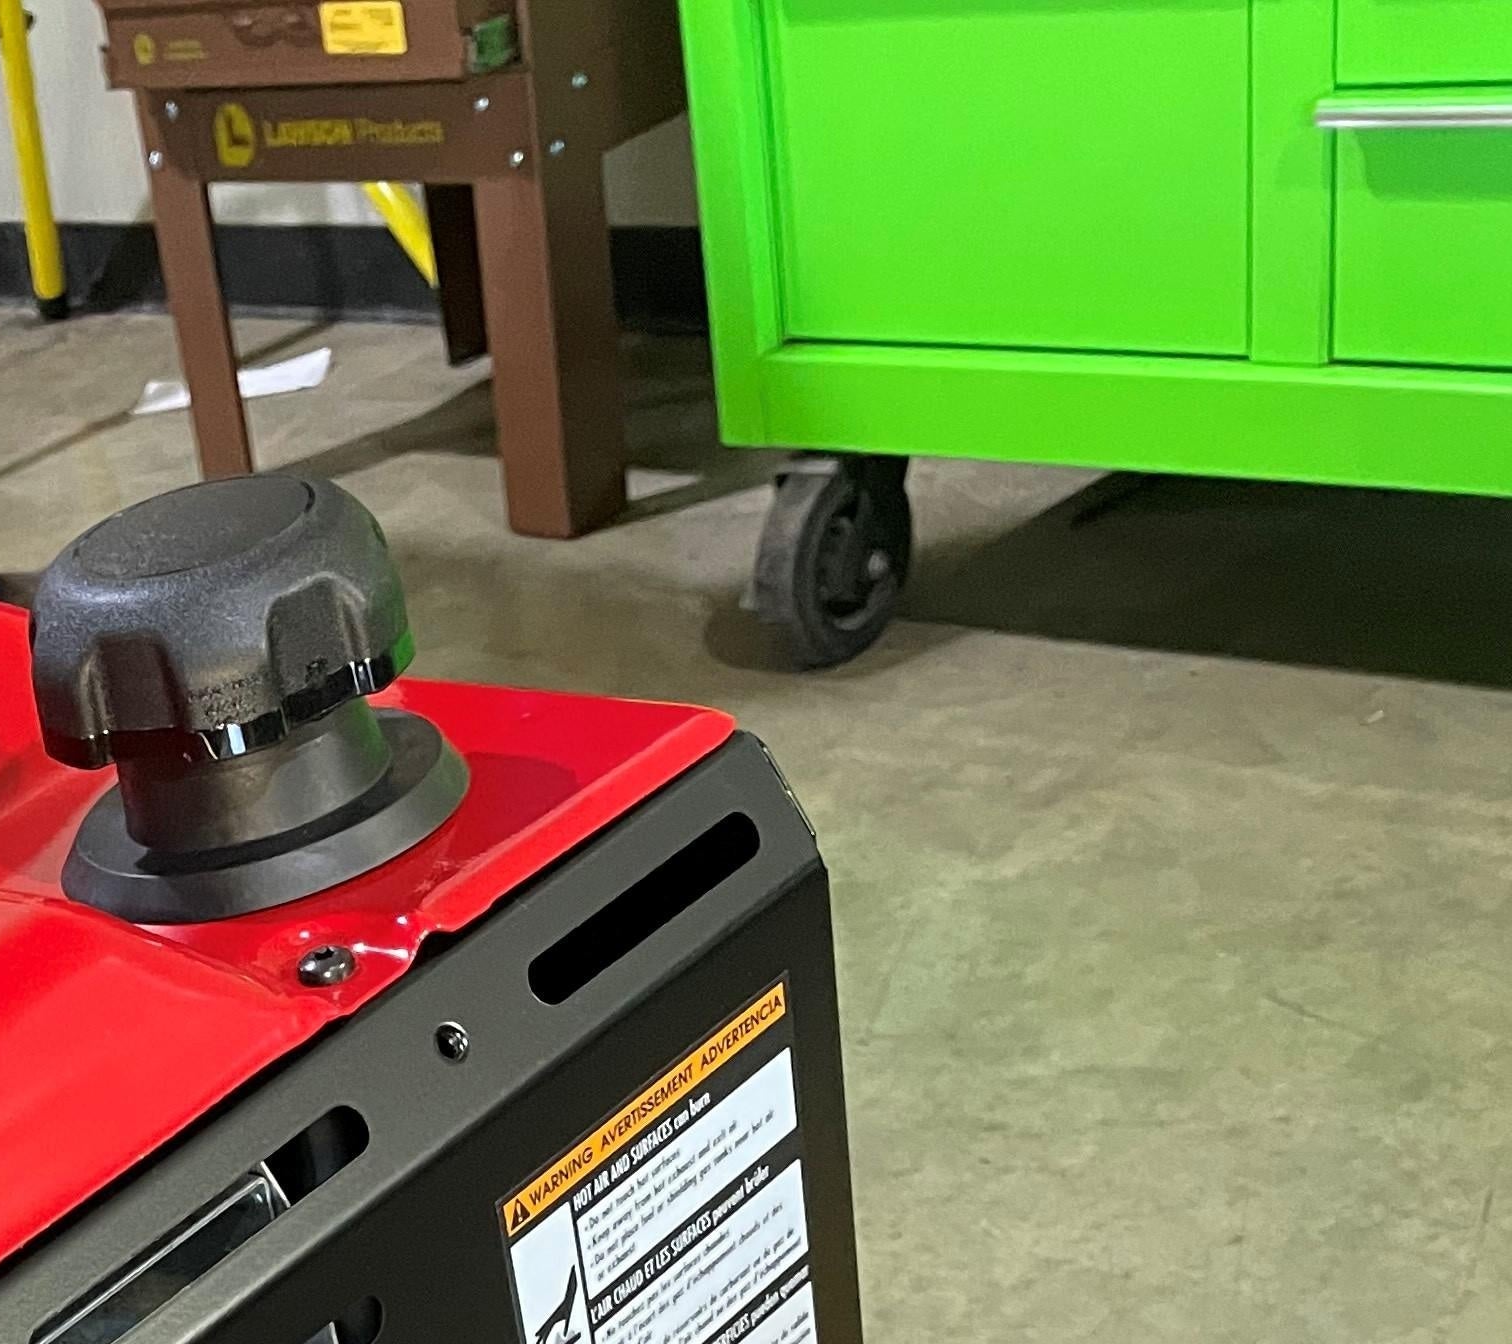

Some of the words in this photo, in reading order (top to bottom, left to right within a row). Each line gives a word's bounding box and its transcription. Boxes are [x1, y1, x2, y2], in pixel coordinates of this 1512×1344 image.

[529, 1146, 594, 1210] WARNING
[599, 1065, 694, 1154] AVERTISSEMENT
[699, 993, 782, 1073] ADVERTENCIA
[572, 1181, 594, 1213] HOT
[592, 1168, 609, 1197] AIR
[609, 1151, 630, 1183] AND
[629, 1116, 673, 1166] SURFACES
[688, 1087, 710, 1119] burn
[590, 1292, 613, 1325] L'AIR
[612, 1265, 644, 1306] CHAUD
[644, 1256, 654, 1280] ET
[655, 1243, 671, 1270] LES
[670, 1210, 711, 1258] SURFACES
